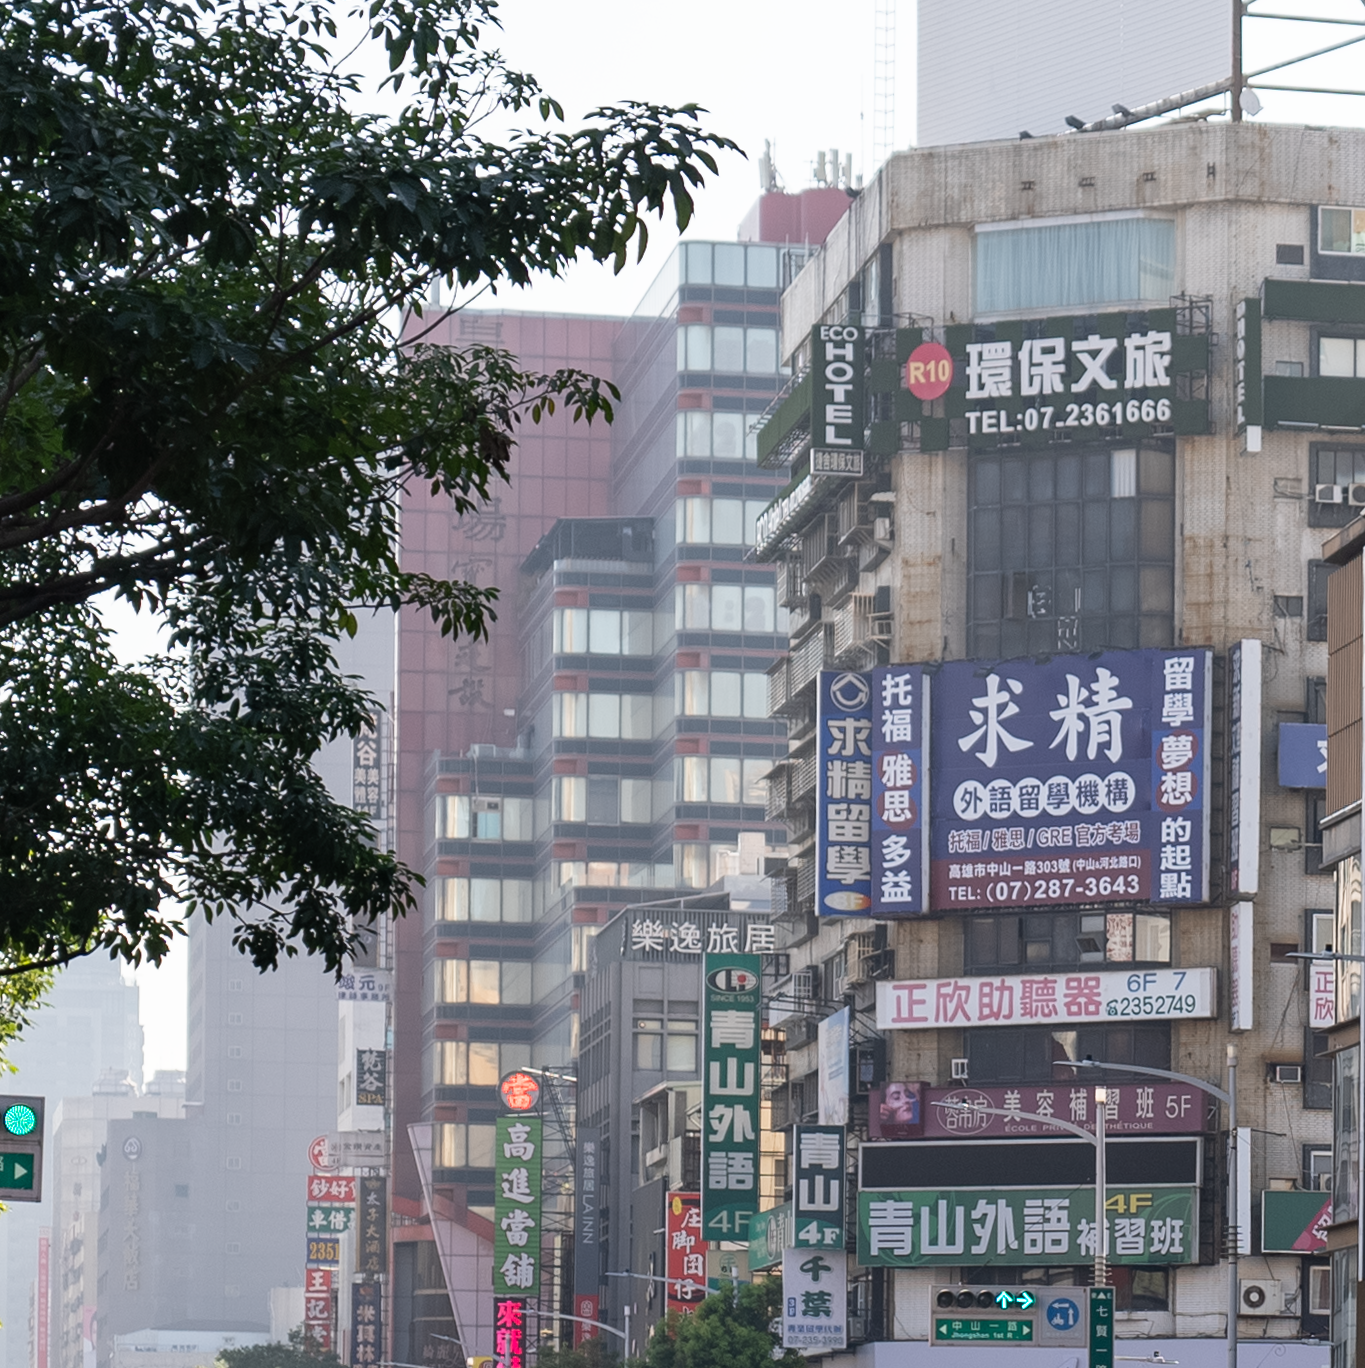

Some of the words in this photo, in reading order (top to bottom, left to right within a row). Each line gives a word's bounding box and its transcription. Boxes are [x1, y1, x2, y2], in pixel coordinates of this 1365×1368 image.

[820, 326, 858, 342] ECO
[909, 359, 950, 384] R10
[965, 330, 1172, 399] 環保文旅
[825, 344, 852, 445] HOTEL
[881, 674, 912, 742] 托福
[957, 667, 1133, 768] 求精
[826, 717, 871, 884] 求精留學
[881, 754, 912, 824] 雅思
[958, 776, 1132, 815] 外語留學機構
[1075, 821, 1141, 847] 官方考場
[881, 835, 912, 903] 多益
[949, 859, 1070, 879] 高雄市中山一路303號
[949, 885, 981, 901] TEL:
[986, 875, 1140, 902] (07)287-3643
[631, 919, 775, 953] 樂逸旅居
[891, 976, 1102, 1024] 正欣助聽器
[1127, 973, 1157, 992] 6F
[1120, 994, 1196, 1016] 2352749
[358, 1094, 384, 1104] SPA
[502, 1072, 538, 1110] 當
[708, 1009, 756, 1191] 青山外語
[1004, 1087, 1155, 1122] 美容補習班
[1165, 1095, 1191, 1118] 5F
[582, 1142, 595, 1191] 樂逸旅居
[799, 1132, 841, 1211] 青山
[501, 1123, 536, 1291] 高進當舖
[708, 1210, 752, 1233] 4F
[1105, 1193, 1153, 1213] 4F
[799, 1221, 840, 1245] 4F
[868, 1198, 1070, 1256] 青山外語
[1077, 1217, 1184, 1256] 補習班
[800, 1256, 832, 1317] 千葉
[952, 1321, 1018, 1332] 中山一路
